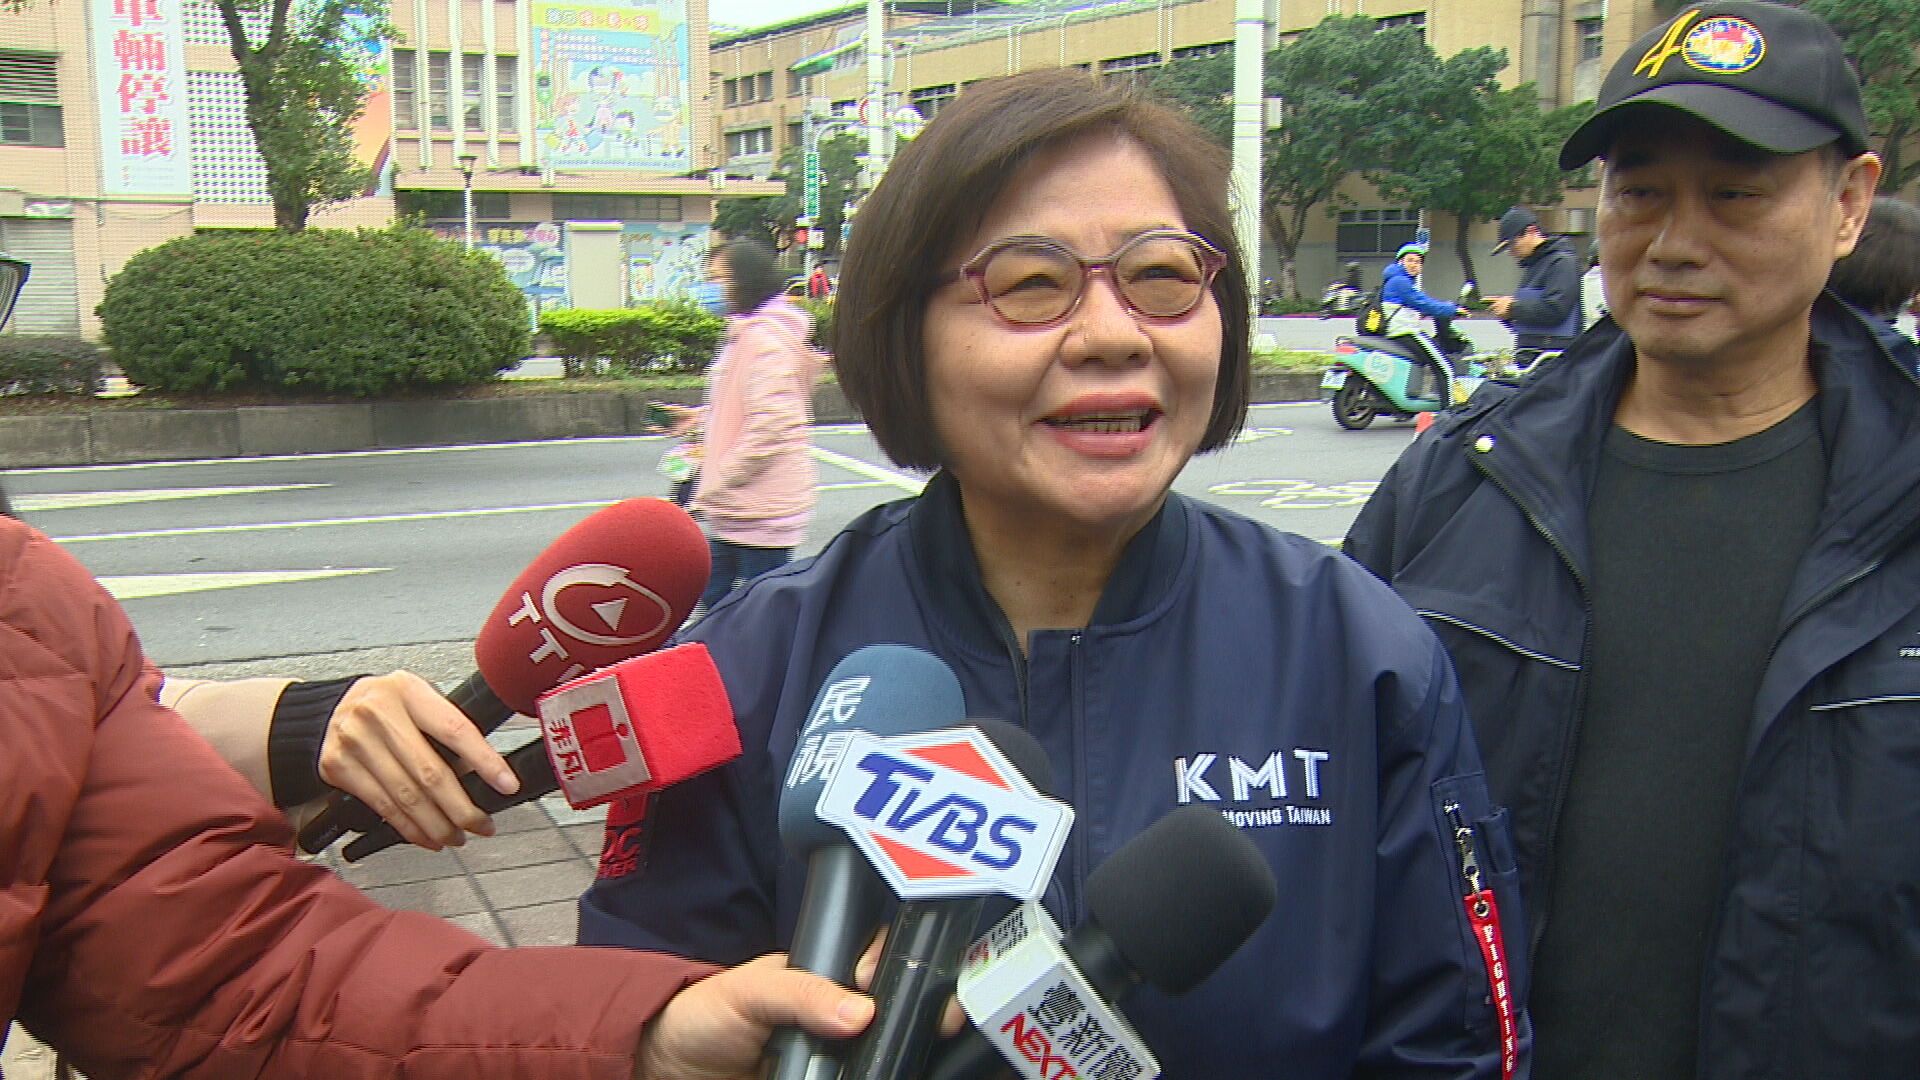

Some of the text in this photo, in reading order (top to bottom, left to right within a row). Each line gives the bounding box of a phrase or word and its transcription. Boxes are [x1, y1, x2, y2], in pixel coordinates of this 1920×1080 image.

[786, 675, 872, 789] 民視
[1175, 749, 1329, 802] KMT
[854, 751, 1037, 870] TVBS
[1000, 1012, 1078, 1080] NEXT
